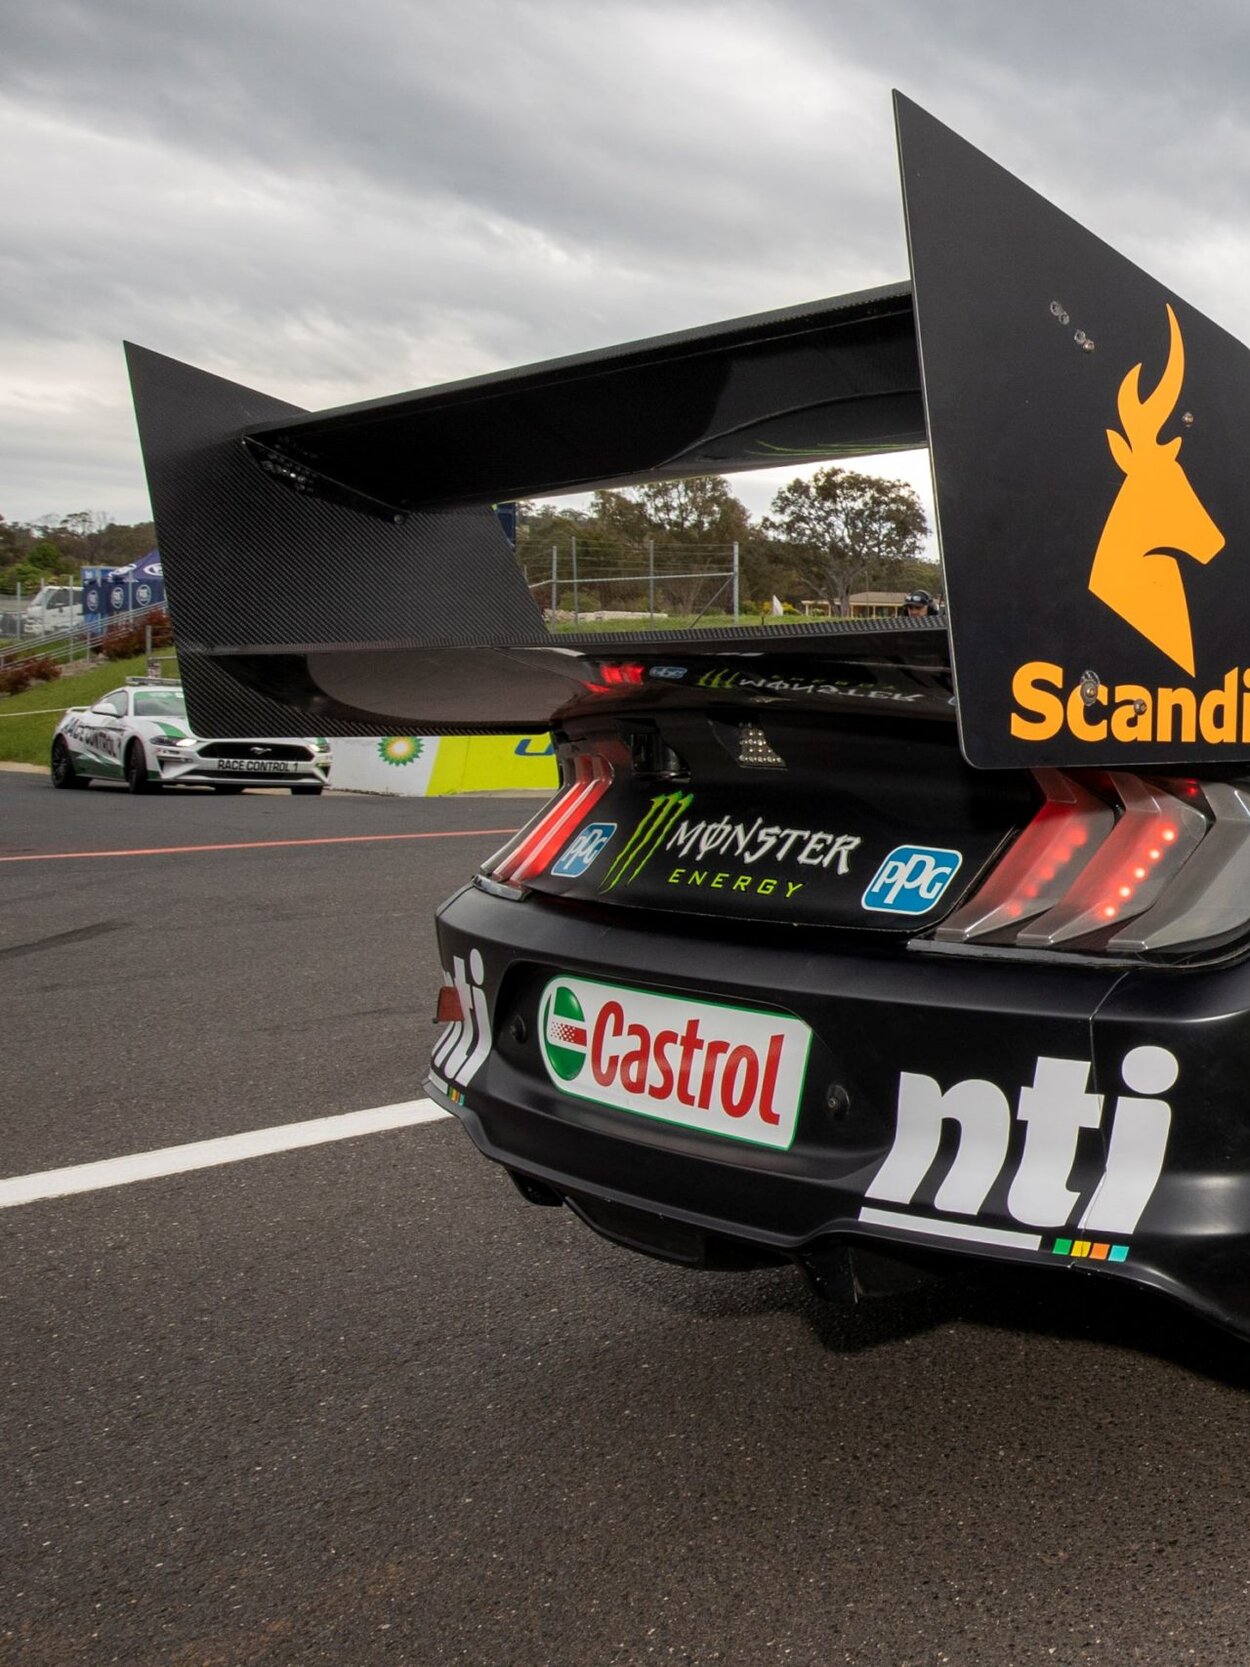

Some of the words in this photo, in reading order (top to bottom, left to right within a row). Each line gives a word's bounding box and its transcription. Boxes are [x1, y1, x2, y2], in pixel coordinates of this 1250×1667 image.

[217, 760, 246, 772] RACE
[247, 760, 290, 773] CONTROL
[293, 761, 299, 772] 1
[667, 868, 806, 899] ENERGY
[871, 852, 950, 905] PPG
[590, 1000, 785, 1126] Castrol
[864, 1045, 1180, 1235] nti
